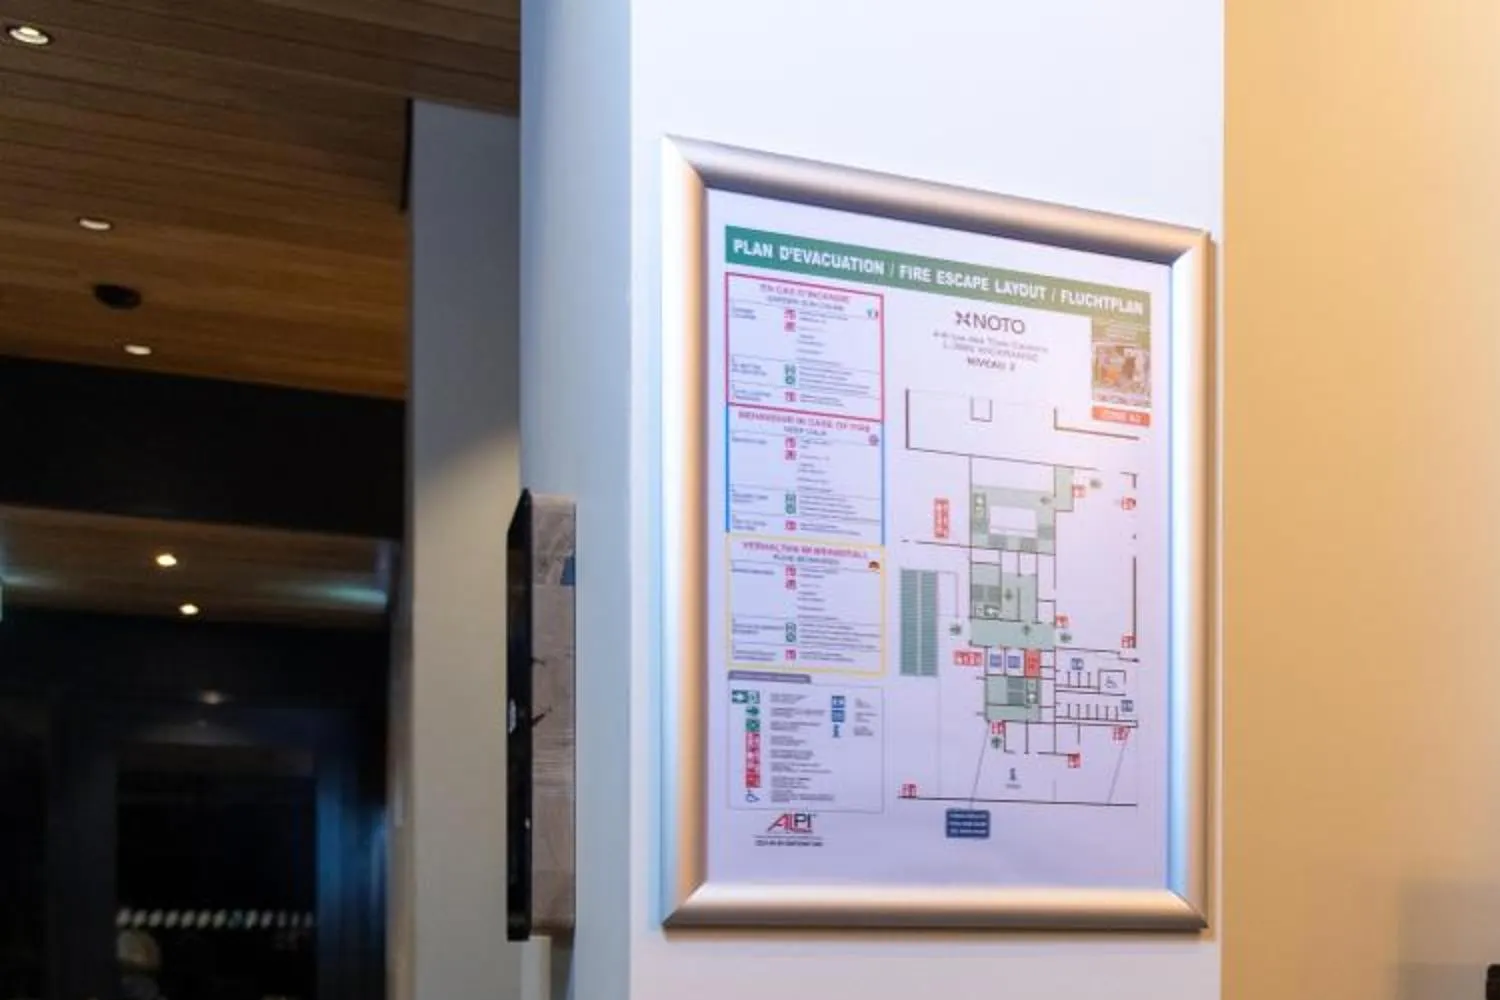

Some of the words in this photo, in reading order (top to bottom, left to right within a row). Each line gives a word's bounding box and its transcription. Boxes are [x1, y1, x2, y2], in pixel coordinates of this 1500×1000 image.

[733, 239, 773, 259] PLAN
[780, 245, 884, 276] D'EVACUATION
[900, 265, 932, 283] FIRE
[936, 269, 990, 291] ESCAPE
[995, 279, 1048, 301] LAYOUT
[1060, 289, 1144, 315] FLUCHTPLAN
[973, 311, 1026, 335] NOTO
